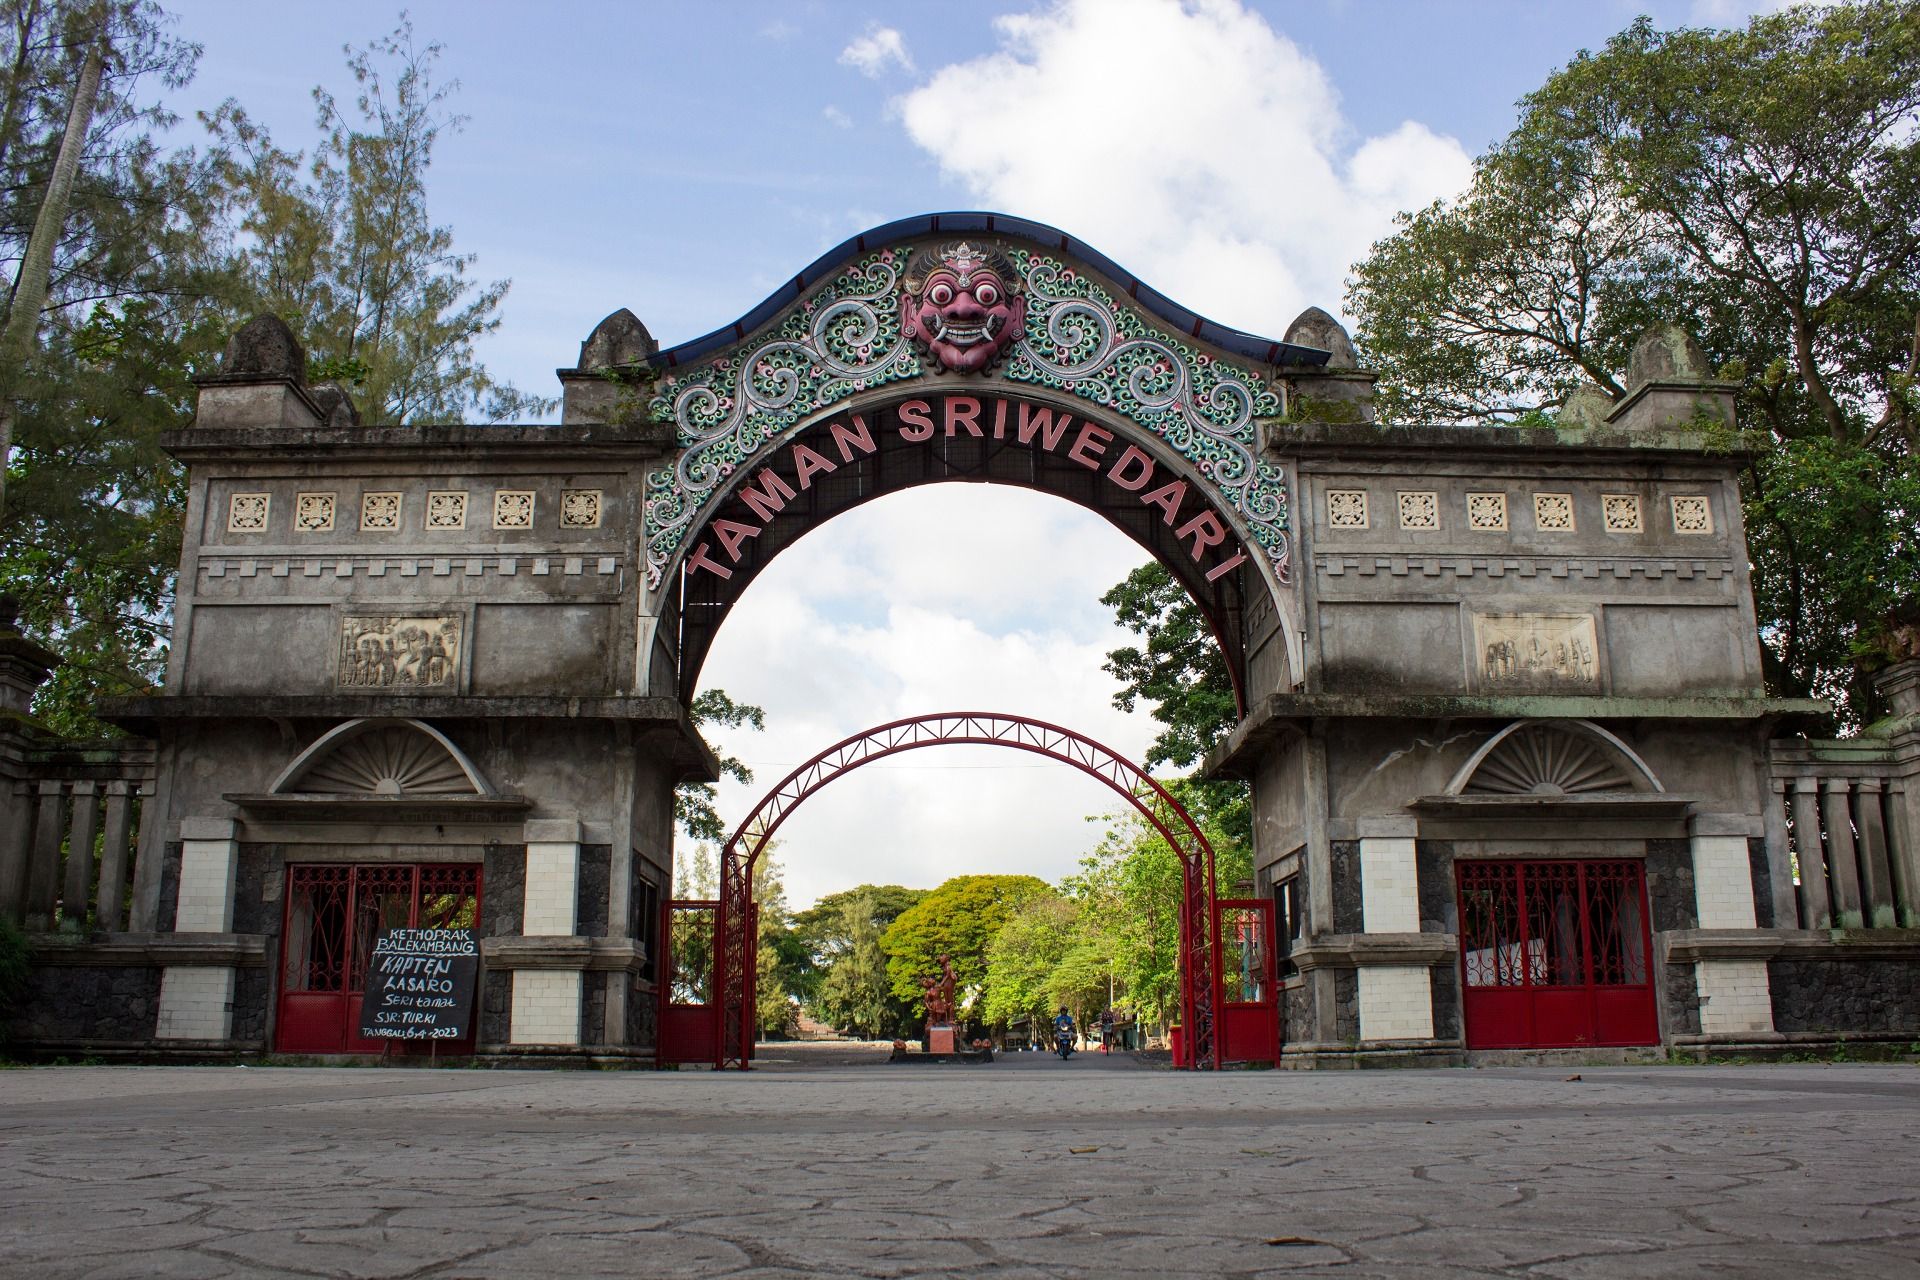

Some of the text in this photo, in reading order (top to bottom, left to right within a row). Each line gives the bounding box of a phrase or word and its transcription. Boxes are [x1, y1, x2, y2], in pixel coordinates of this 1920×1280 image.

[686, 396, 1248, 583] TAMAN SRIWEDARI
[389, 929, 470, 941] KETHOPRAK
[376, 938, 475, 953] BALEKAMBANG
[380, 956, 452, 976] KAPTEN
[381, 994, 456, 1007] SERI tamat
[402, 1011, 437, 1025] TURKI
